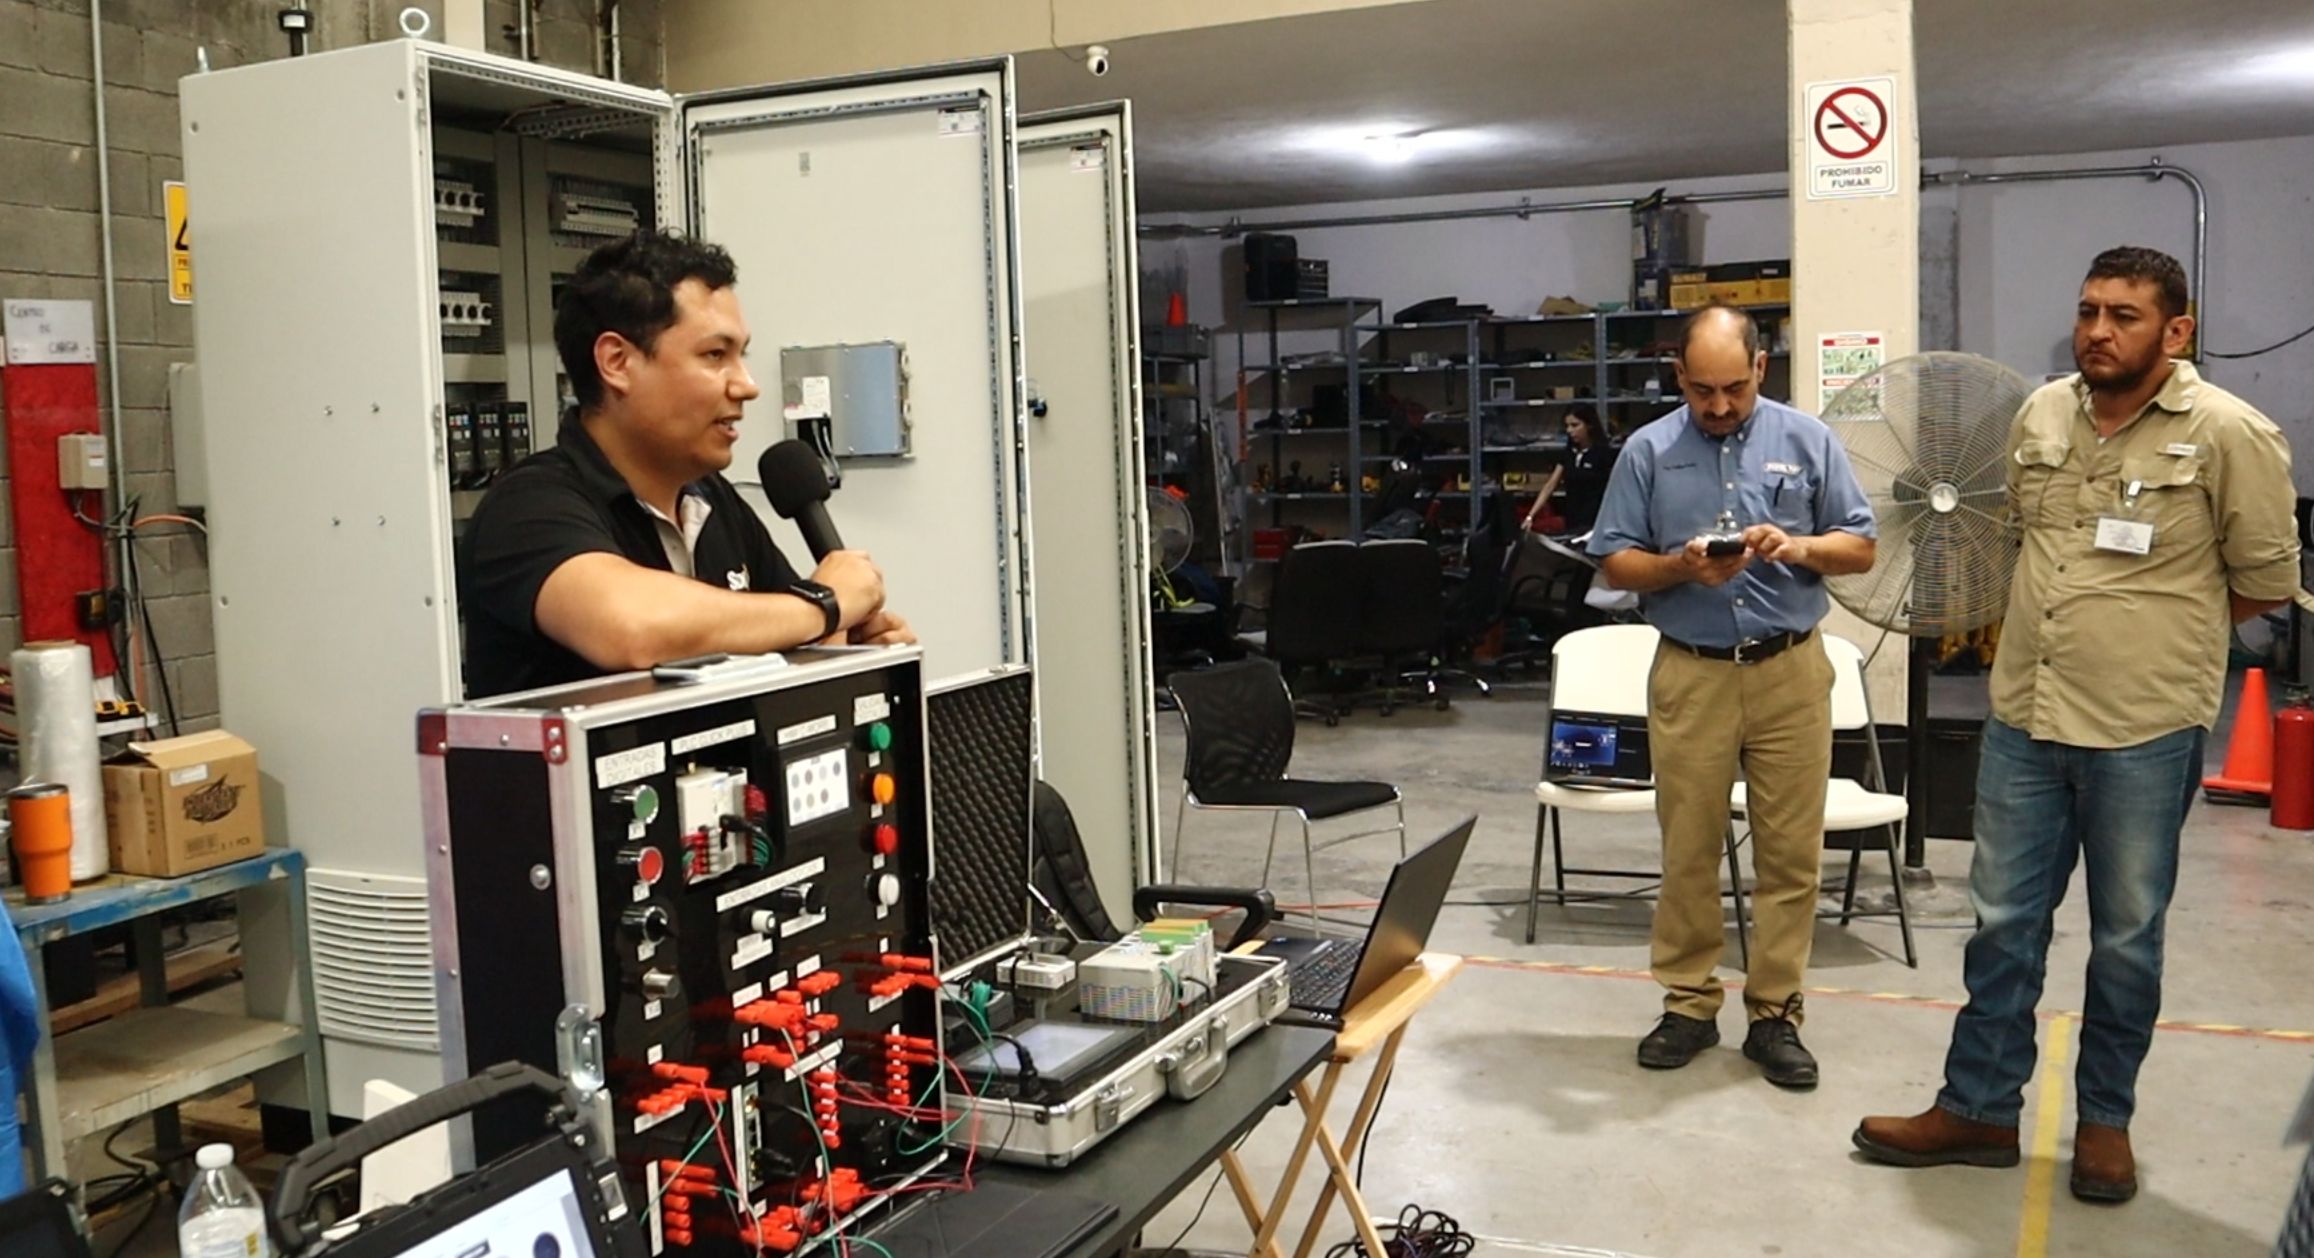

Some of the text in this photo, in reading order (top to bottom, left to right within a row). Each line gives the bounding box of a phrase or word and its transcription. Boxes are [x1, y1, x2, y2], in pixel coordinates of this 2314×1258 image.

[1820, 165, 1882, 178] PROHIBIDO
[1832, 177, 1871, 188] FUMAR
[604, 746, 657, 770] ENTRADAS
